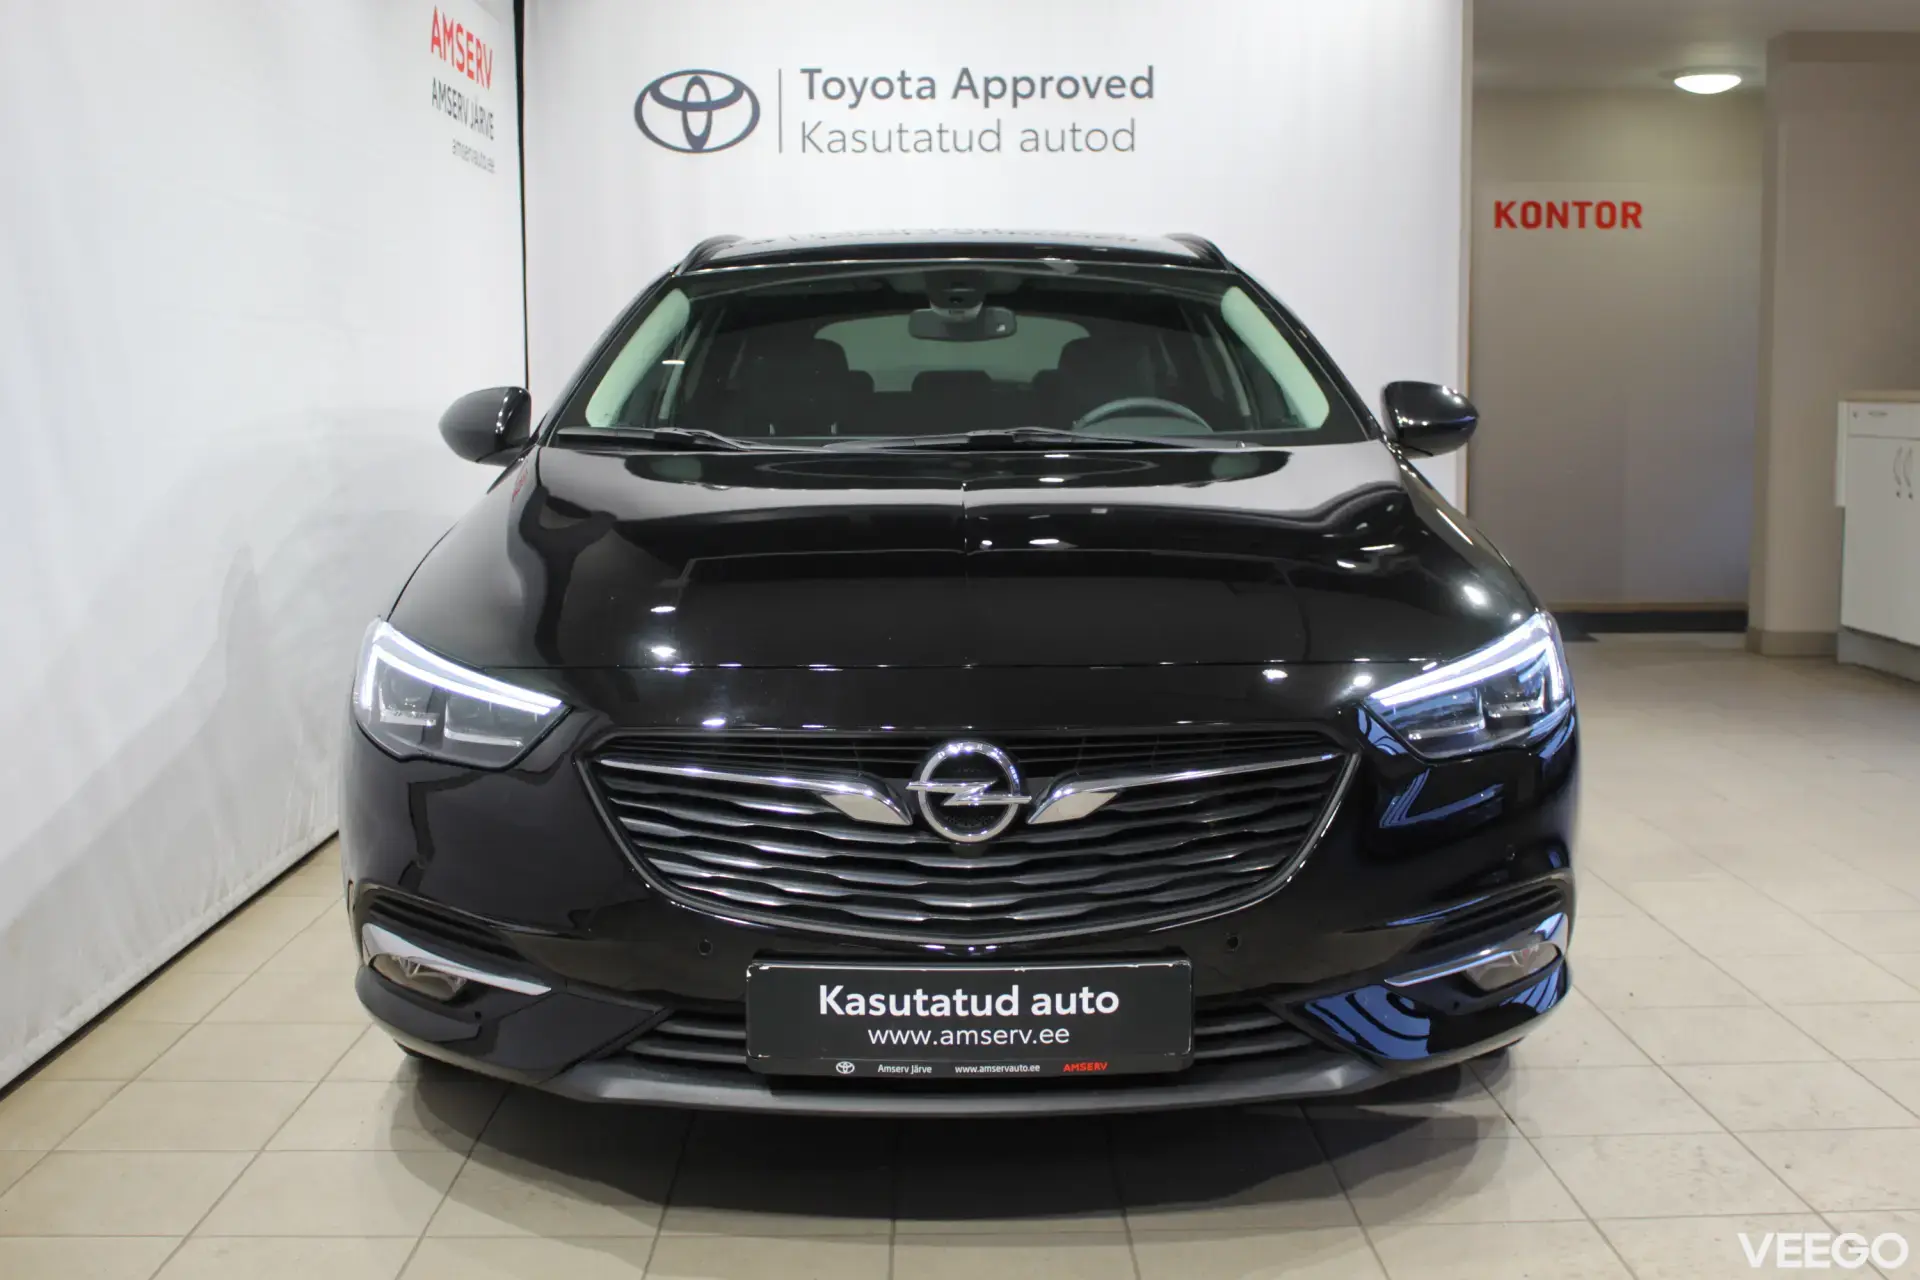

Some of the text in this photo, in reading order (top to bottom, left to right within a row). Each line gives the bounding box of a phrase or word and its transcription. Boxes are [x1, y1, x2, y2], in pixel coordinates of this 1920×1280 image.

[431, 4, 493, 91] AMSERV
[431, 76, 470, 128] AMSERV
[800, 65, 1154, 109] Toyota Approved
[801, 118, 1136, 153] Kasutatud autod
[1494, 201, 1643, 229] KONTOR
[819, 984, 1119, 1017] Kasutatud auto
[868, 1028, 1070, 1045] www.amserv.ee
[877, 1063, 932, 1074] Amserv Järve
[955, 1063, 1041, 1074] www.amservauto.ee
[1063, 1062, 1108, 1072] AMSERV
